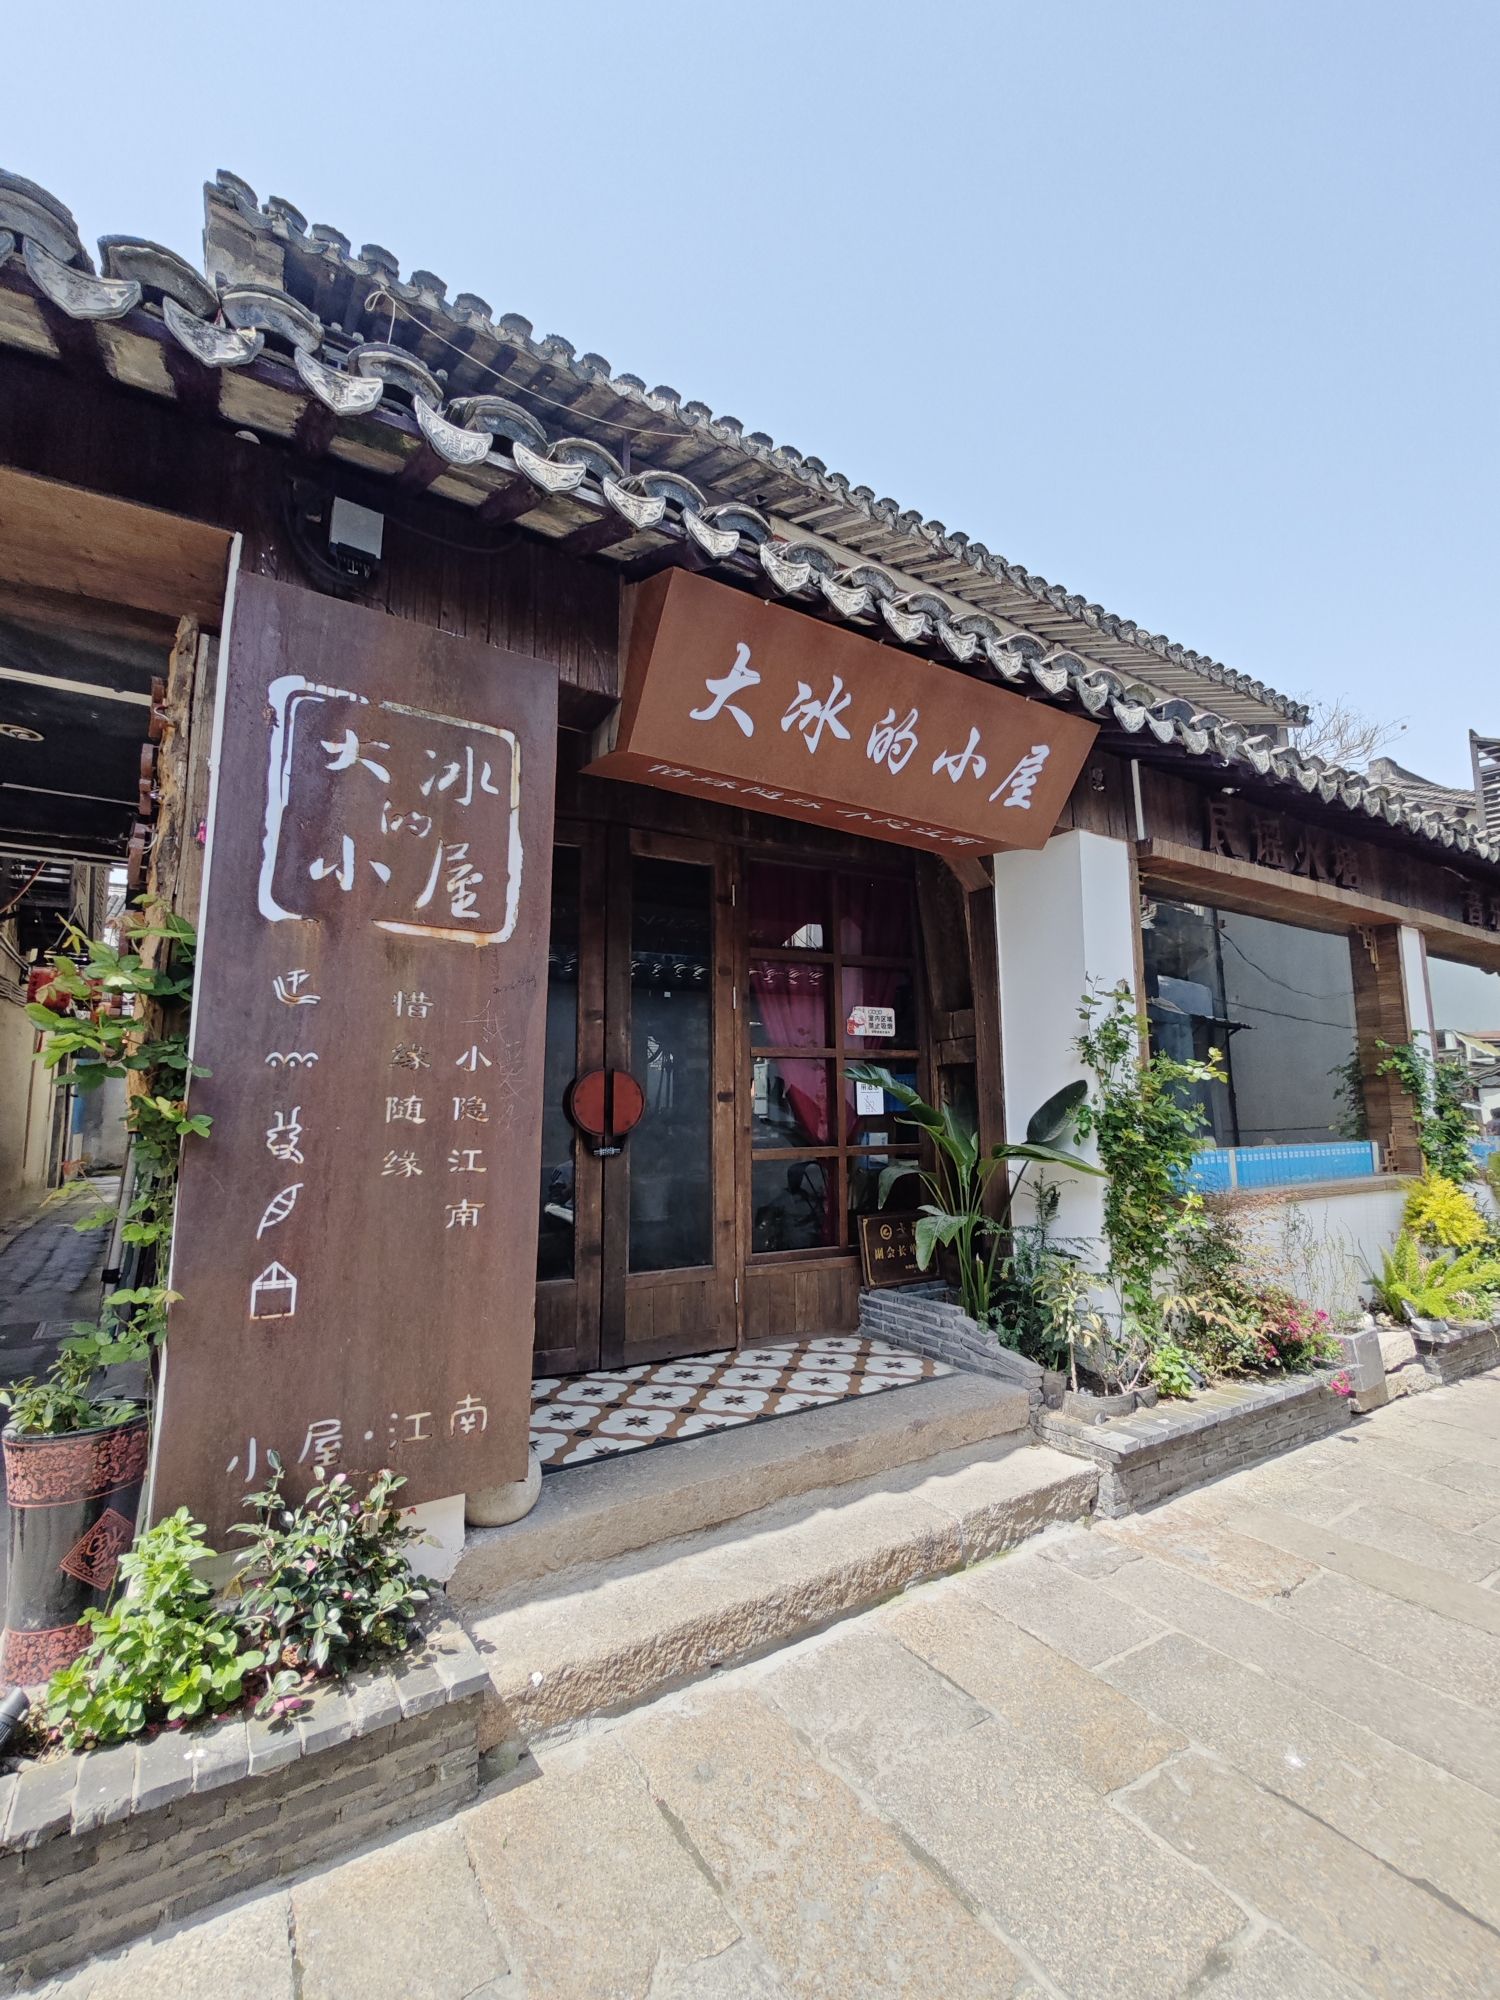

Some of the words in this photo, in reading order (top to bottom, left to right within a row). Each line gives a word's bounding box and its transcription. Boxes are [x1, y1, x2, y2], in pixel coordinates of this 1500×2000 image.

[319, 728, 500, 807] 大冰
[689, 642, 1051, 810] 大冰的小屋
[308, 834, 484, 919] 小屋
[380, 800, 433, 838] 的
[380, 990, 434, 1178] 惜缘随缘
[443, 1045, 492, 1230] 小隐江南
